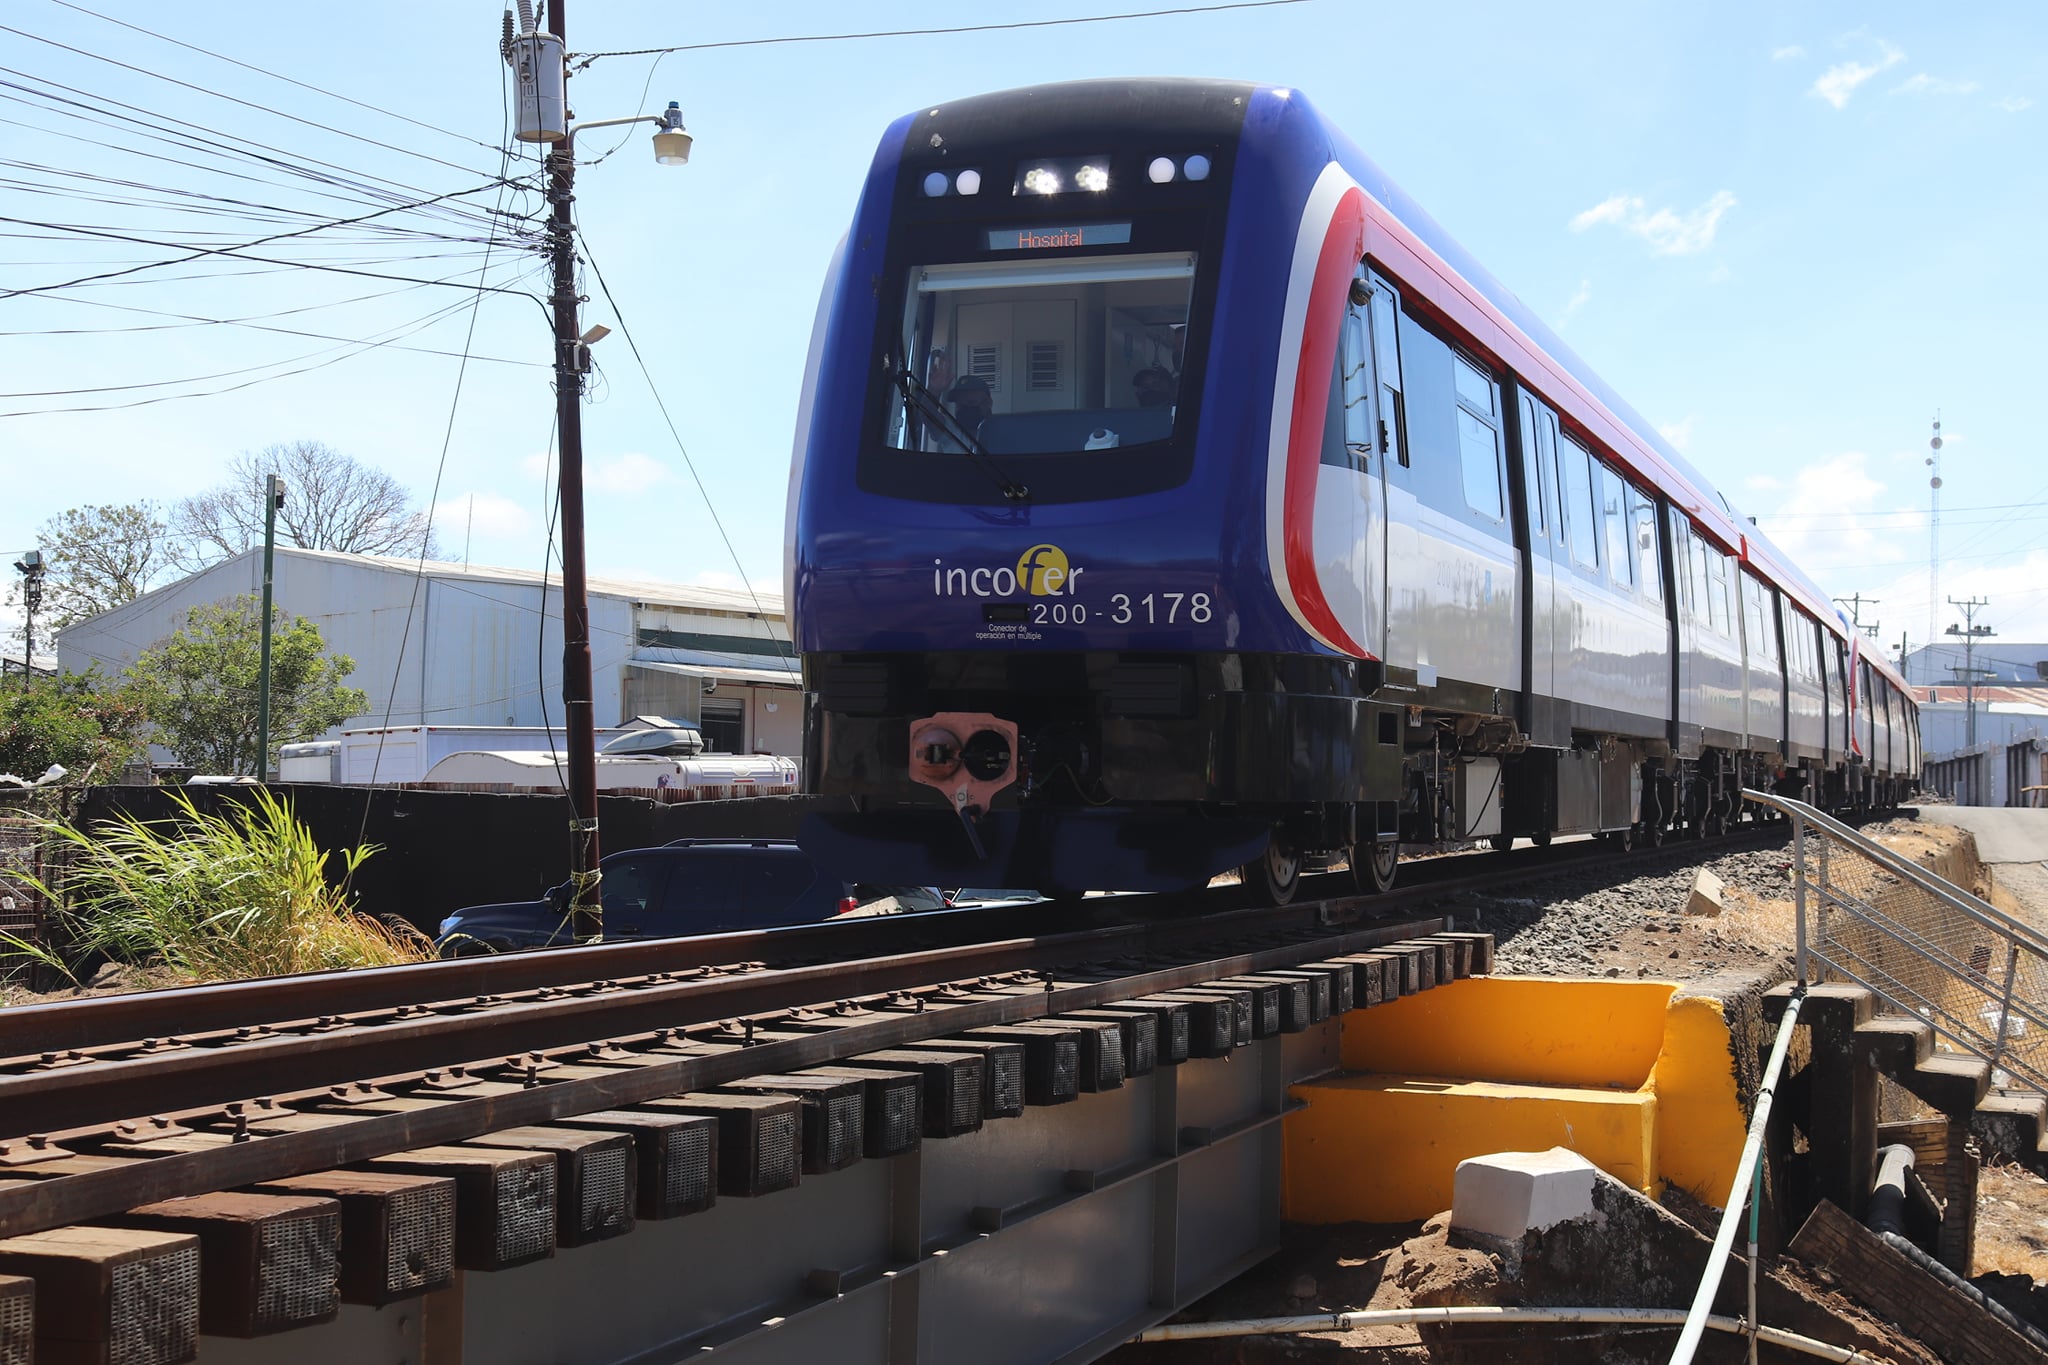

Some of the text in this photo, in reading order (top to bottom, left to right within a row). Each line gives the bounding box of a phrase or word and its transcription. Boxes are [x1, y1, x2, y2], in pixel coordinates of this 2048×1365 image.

[1019, 228, 1082, 248] Hospital
[934, 547, 1083, 597] incofer
[1110, 592, 1212, 624] 3178
[988, 623, 1027, 632] Conector de
